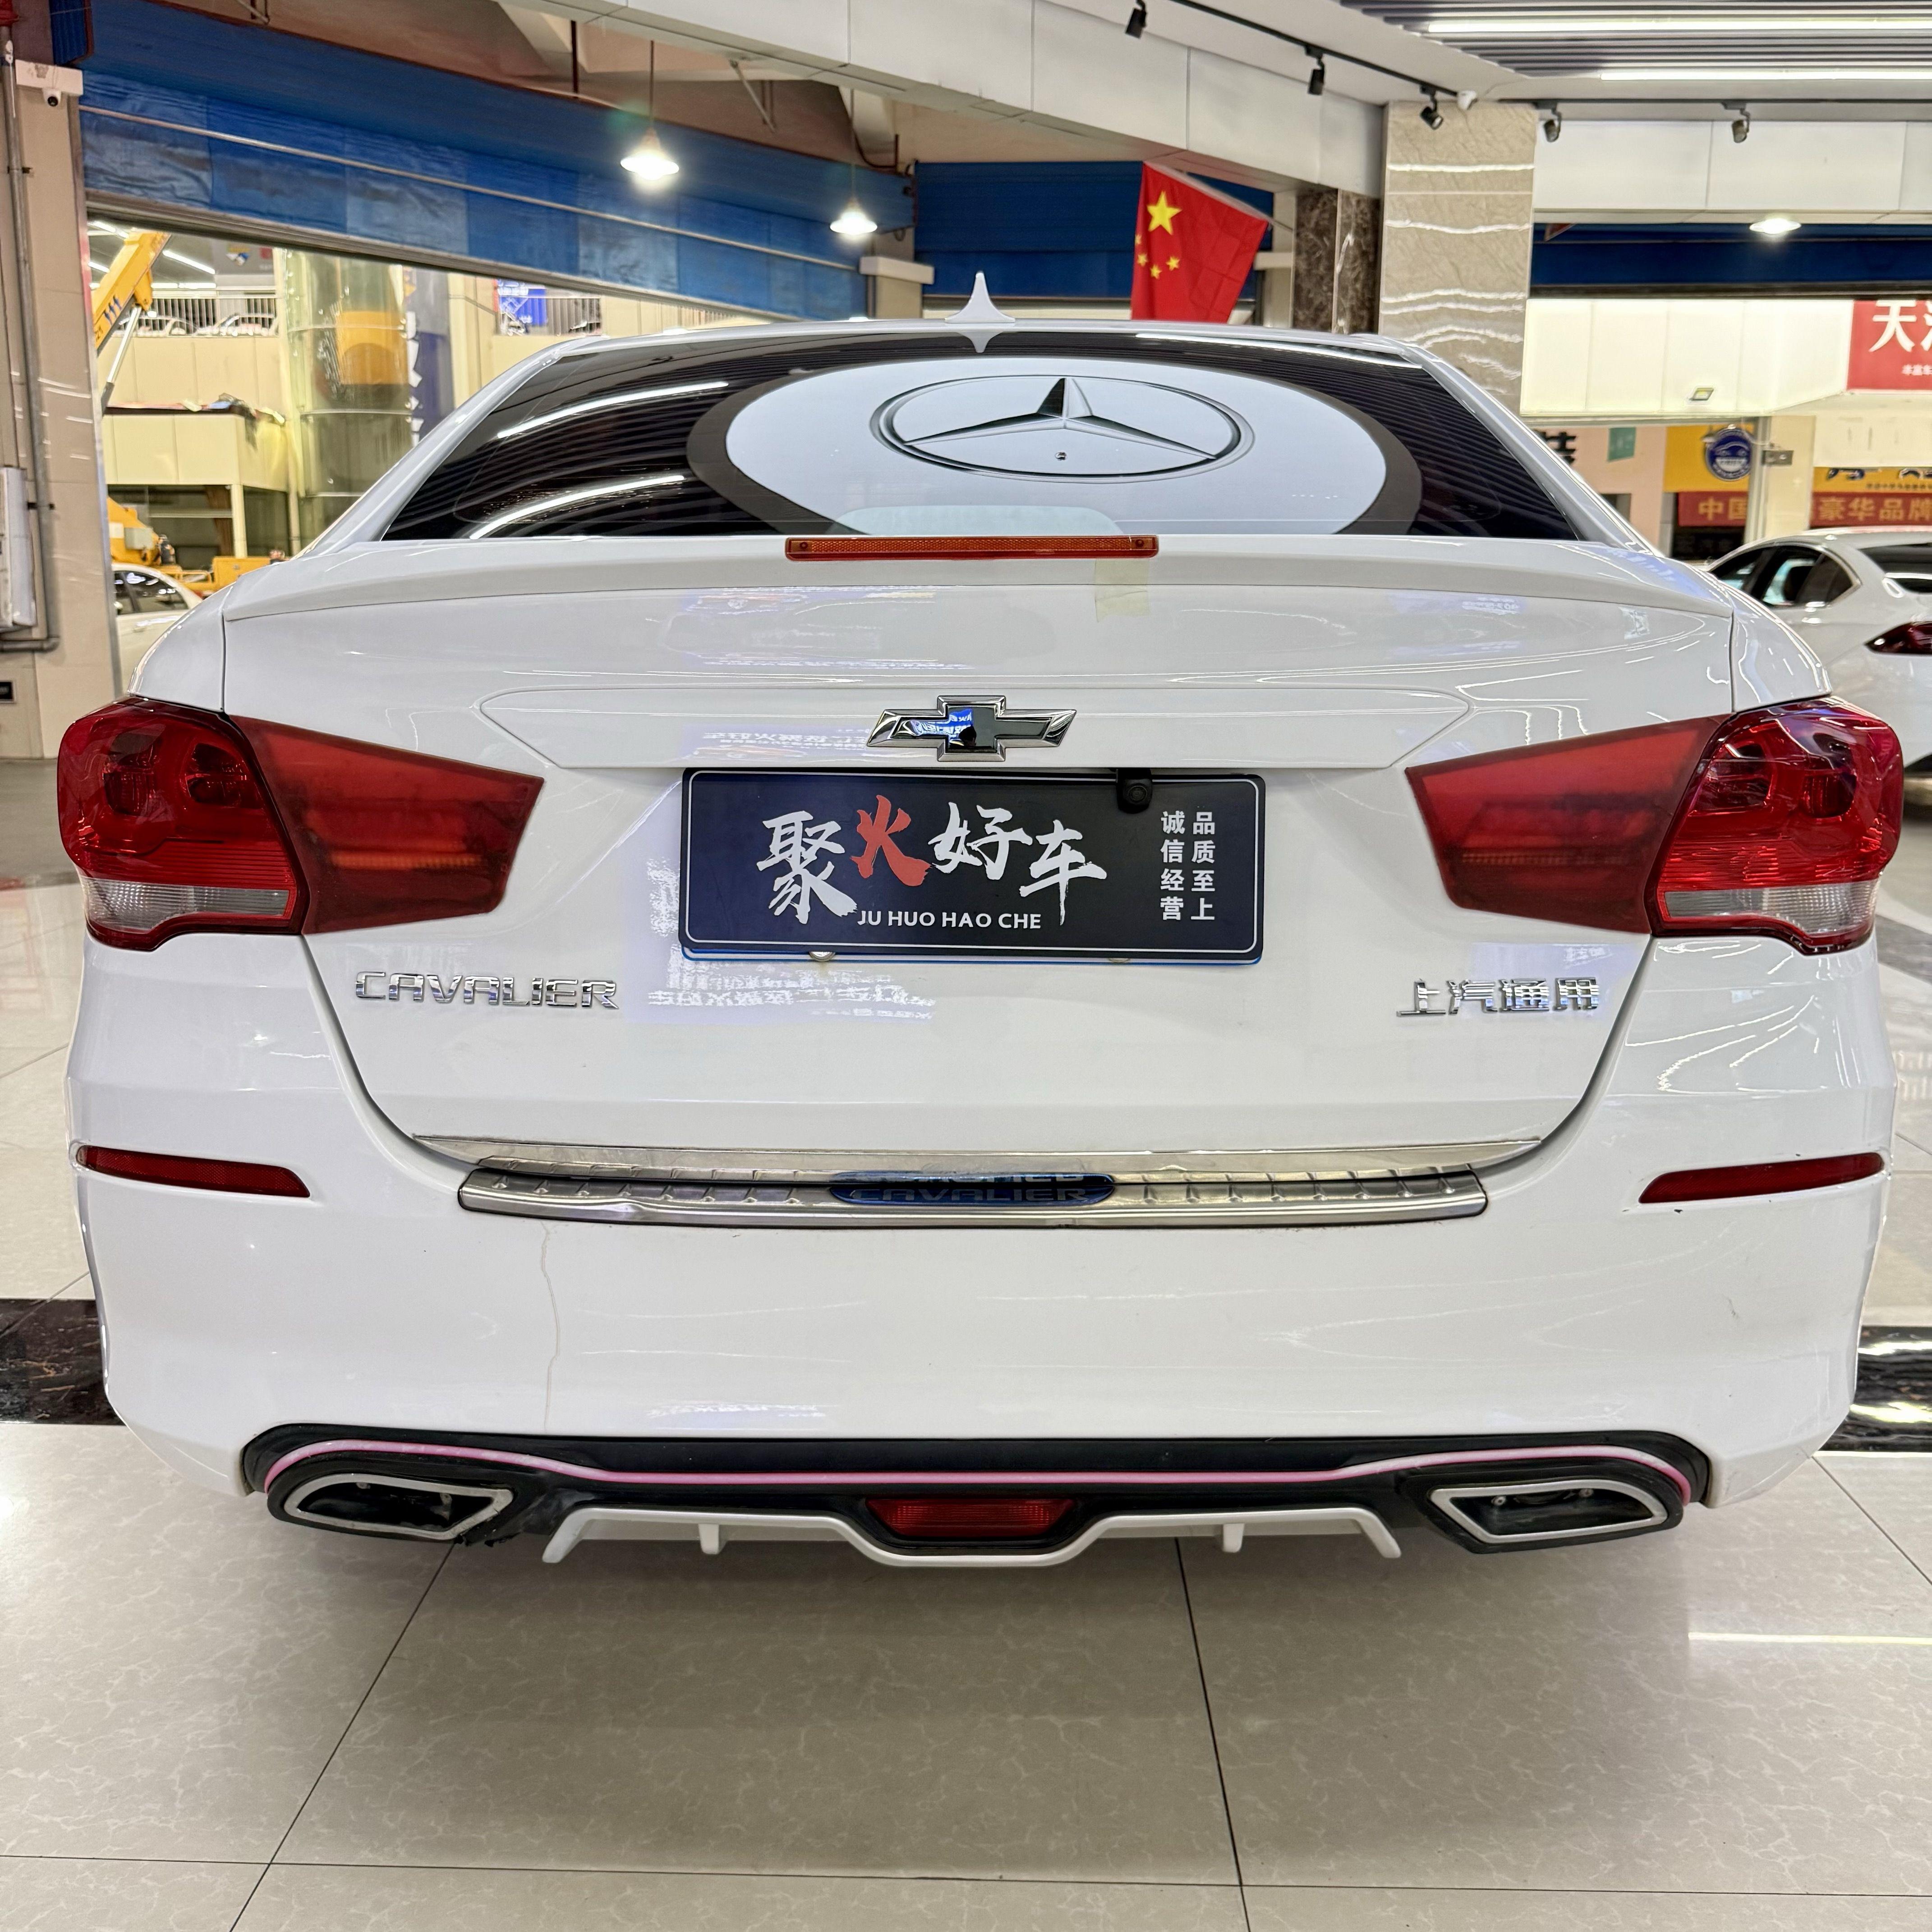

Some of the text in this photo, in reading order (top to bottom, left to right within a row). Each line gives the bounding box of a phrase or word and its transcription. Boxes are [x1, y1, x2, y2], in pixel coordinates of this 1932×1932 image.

[1868, 300, 1932, 352] 天
[756, 795, 1107, 926] 聚火好车
[1160, 810, 1185, 920] 诚信经营
[1191, 812, 1215, 920] 品质至上
[857, 911, 1041, 929] JU HUO HAO CHE
[355, 971, 619, 1009] CAVALIER
[1396, 977, 1600, 1017] 上汽通用
[850, 1187, 1086, 1201] CAVALIER
